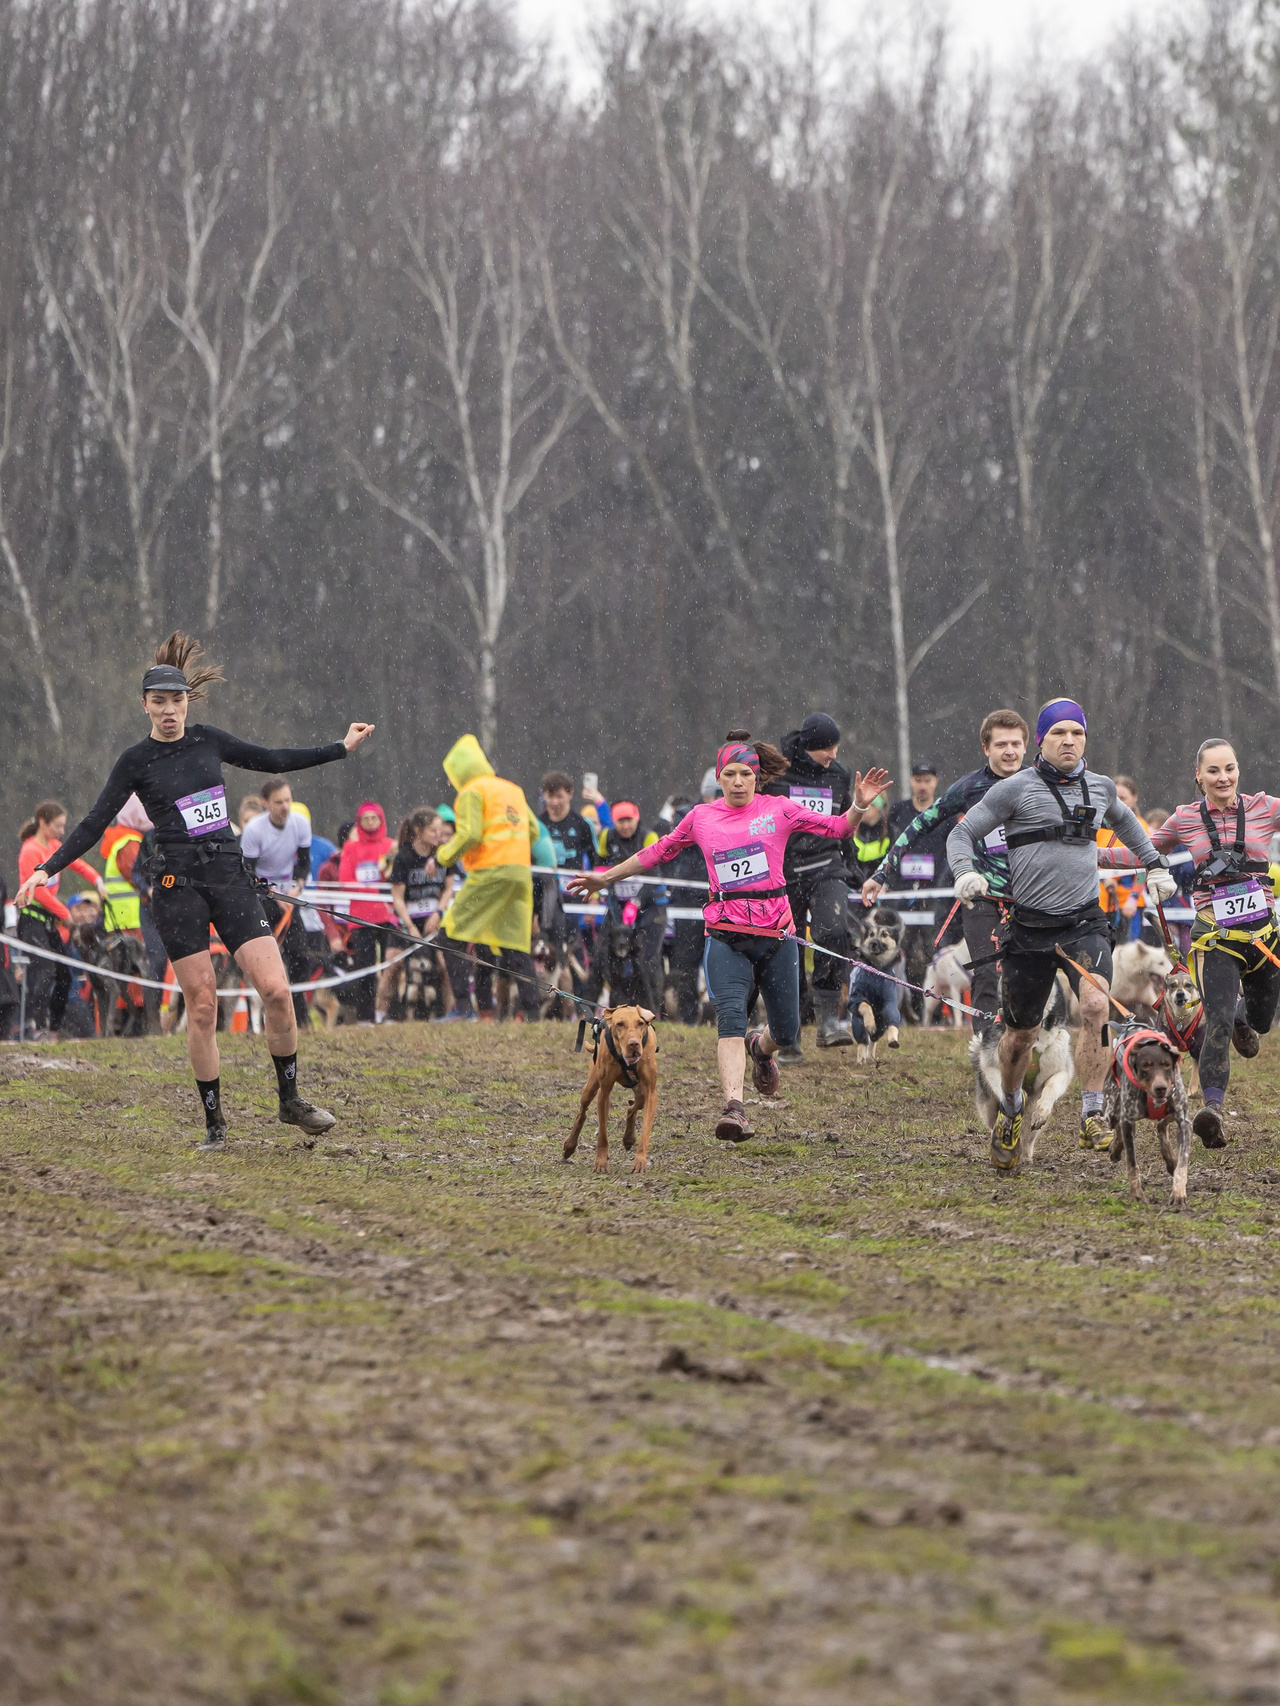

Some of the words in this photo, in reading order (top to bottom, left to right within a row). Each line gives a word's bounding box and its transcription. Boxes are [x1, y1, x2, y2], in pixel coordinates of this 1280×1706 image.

[194, 802, 221, 823] 345
[731, 860, 752, 878] 92
[1225, 895, 1257, 915] 374
